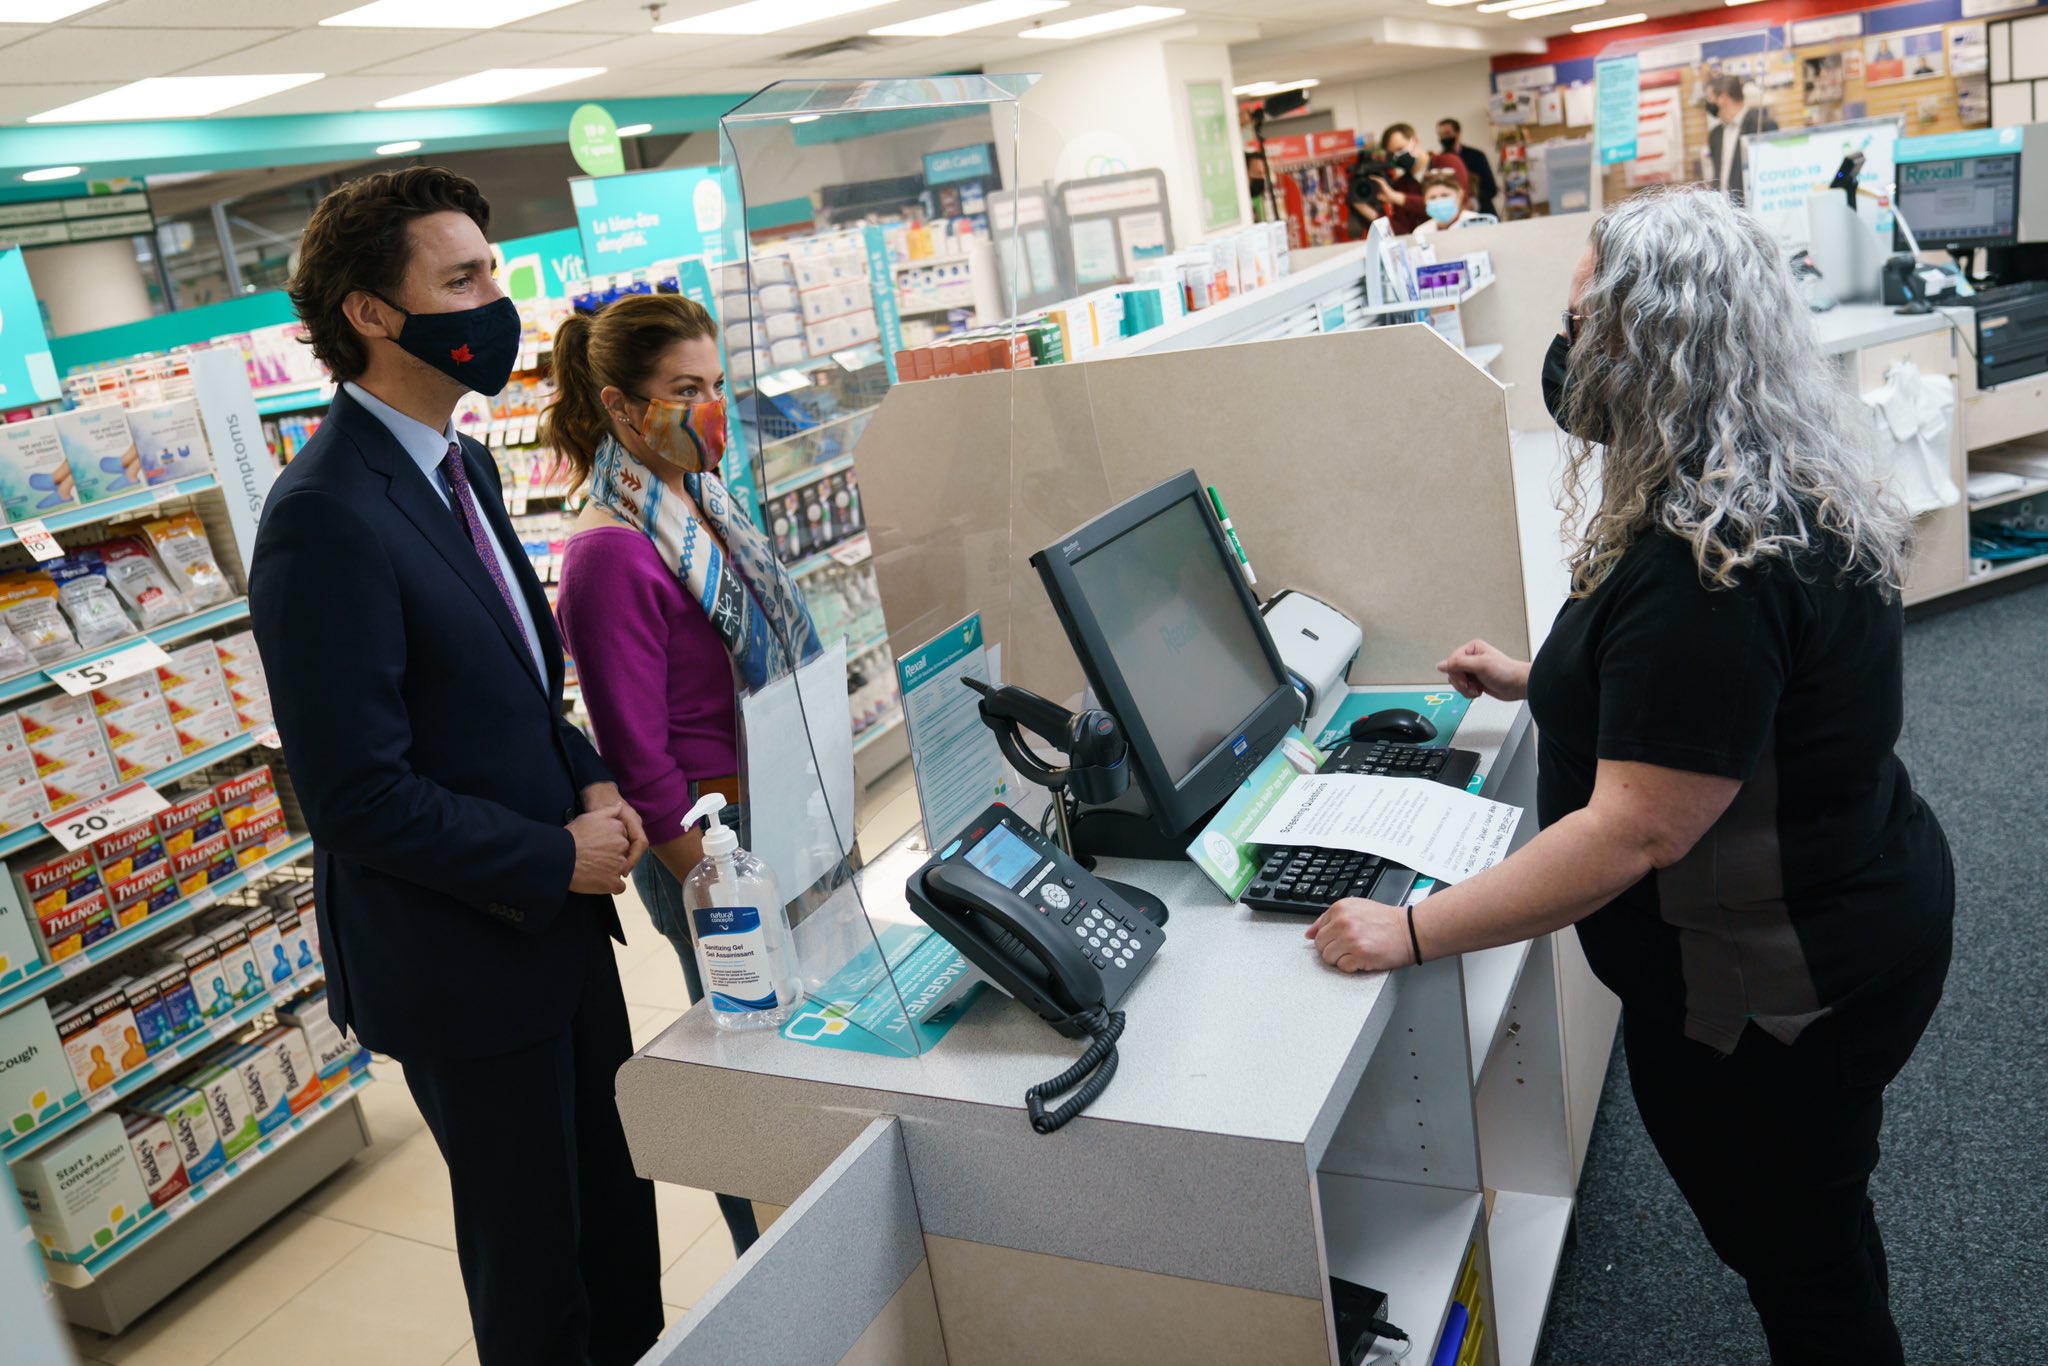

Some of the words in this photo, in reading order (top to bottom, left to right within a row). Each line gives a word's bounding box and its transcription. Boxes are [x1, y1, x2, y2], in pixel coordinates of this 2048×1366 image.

[932, 159, 950, 173] Gift
[951, 152, 983, 169] Cards
[1759, 165, 1821, 182] COVID-19
[1904, 160, 1964, 185] Rexall
[592, 219, 608, 235] Le
[608, 211, 660, 232] bien-être
[31, 441, 42, 450] and
[226, 413, 262, 512] symptoms
[61, 566, 90, 579] Rexall
[8, 587, 40, 600] Rexall
[905, 654, 928, 678] Rexall
[222, 773, 267, 806] TYLENOL
[163, 798, 211, 829] TYLENOL
[1280, 807, 1310, 833] Screening
[1301, 782, 1328, 808] Questions
[101, 825, 153, 859] TYLENOL
[235, 813, 279, 847] TYLENOL
[178, 840, 225, 871] TYLENOL
[31, 856, 89, 889] TYLENOL
[116, 869, 167, 902] TYLENOL
[47, 901, 103, 934] TYLENOL
[710, 911, 734, 920] natural
[218, 931, 246, 951] BENYLIN
[704, 943, 731, 952] Sanitizing
[716, 950, 755, 959] Assainissant
[187, 947, 216, 968] BENYLIN
[160, 969, 187, 989] BENYLIN
[93, 993, 126, 1016] BENYLIN
[130, 986, 158, 1004] BENYLIN
[59, 1012, 92, 1036] BENYLIN
[0, 1045, 38, 1073] Cough
[277, 1043, 299, 1093] Buckley's
[246, 1063, 268, 1115] Buckley's
[213, 1085, 236, 1137] Buckley's
[177, 1110, 200, 1162] Buckley's
[56, 1158, 84, 1183] Start
[86, 1153, 93, 1163] a
[60, 1144, 125, 1191] conversation
[140, 1138, 162, 1187] Buckley's
